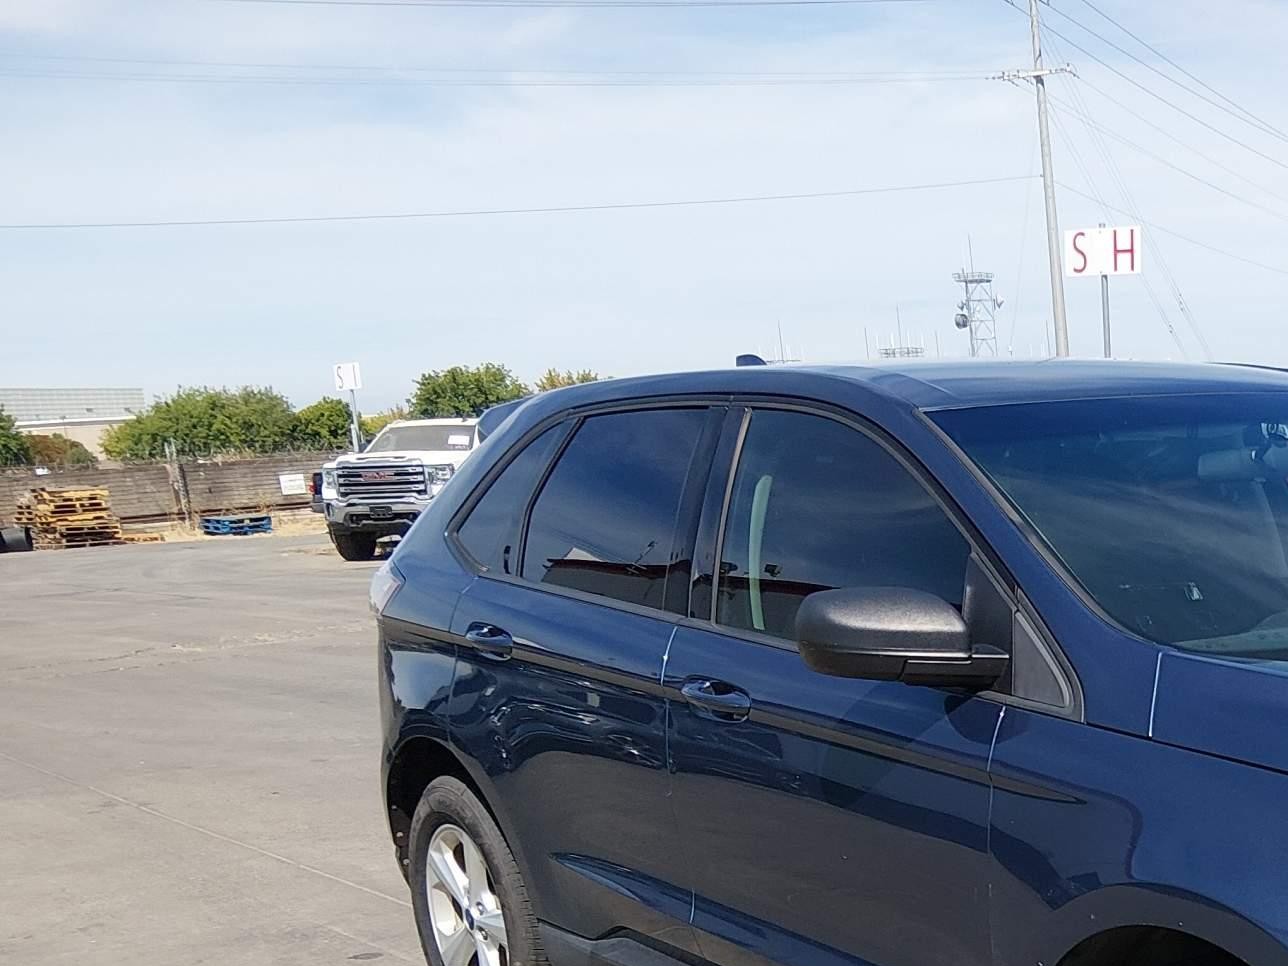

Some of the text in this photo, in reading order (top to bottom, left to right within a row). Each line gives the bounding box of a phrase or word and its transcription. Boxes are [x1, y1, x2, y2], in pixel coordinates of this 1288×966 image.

[1073, 228, 1135, 273] S H
[336, 365, 344, 389] S
